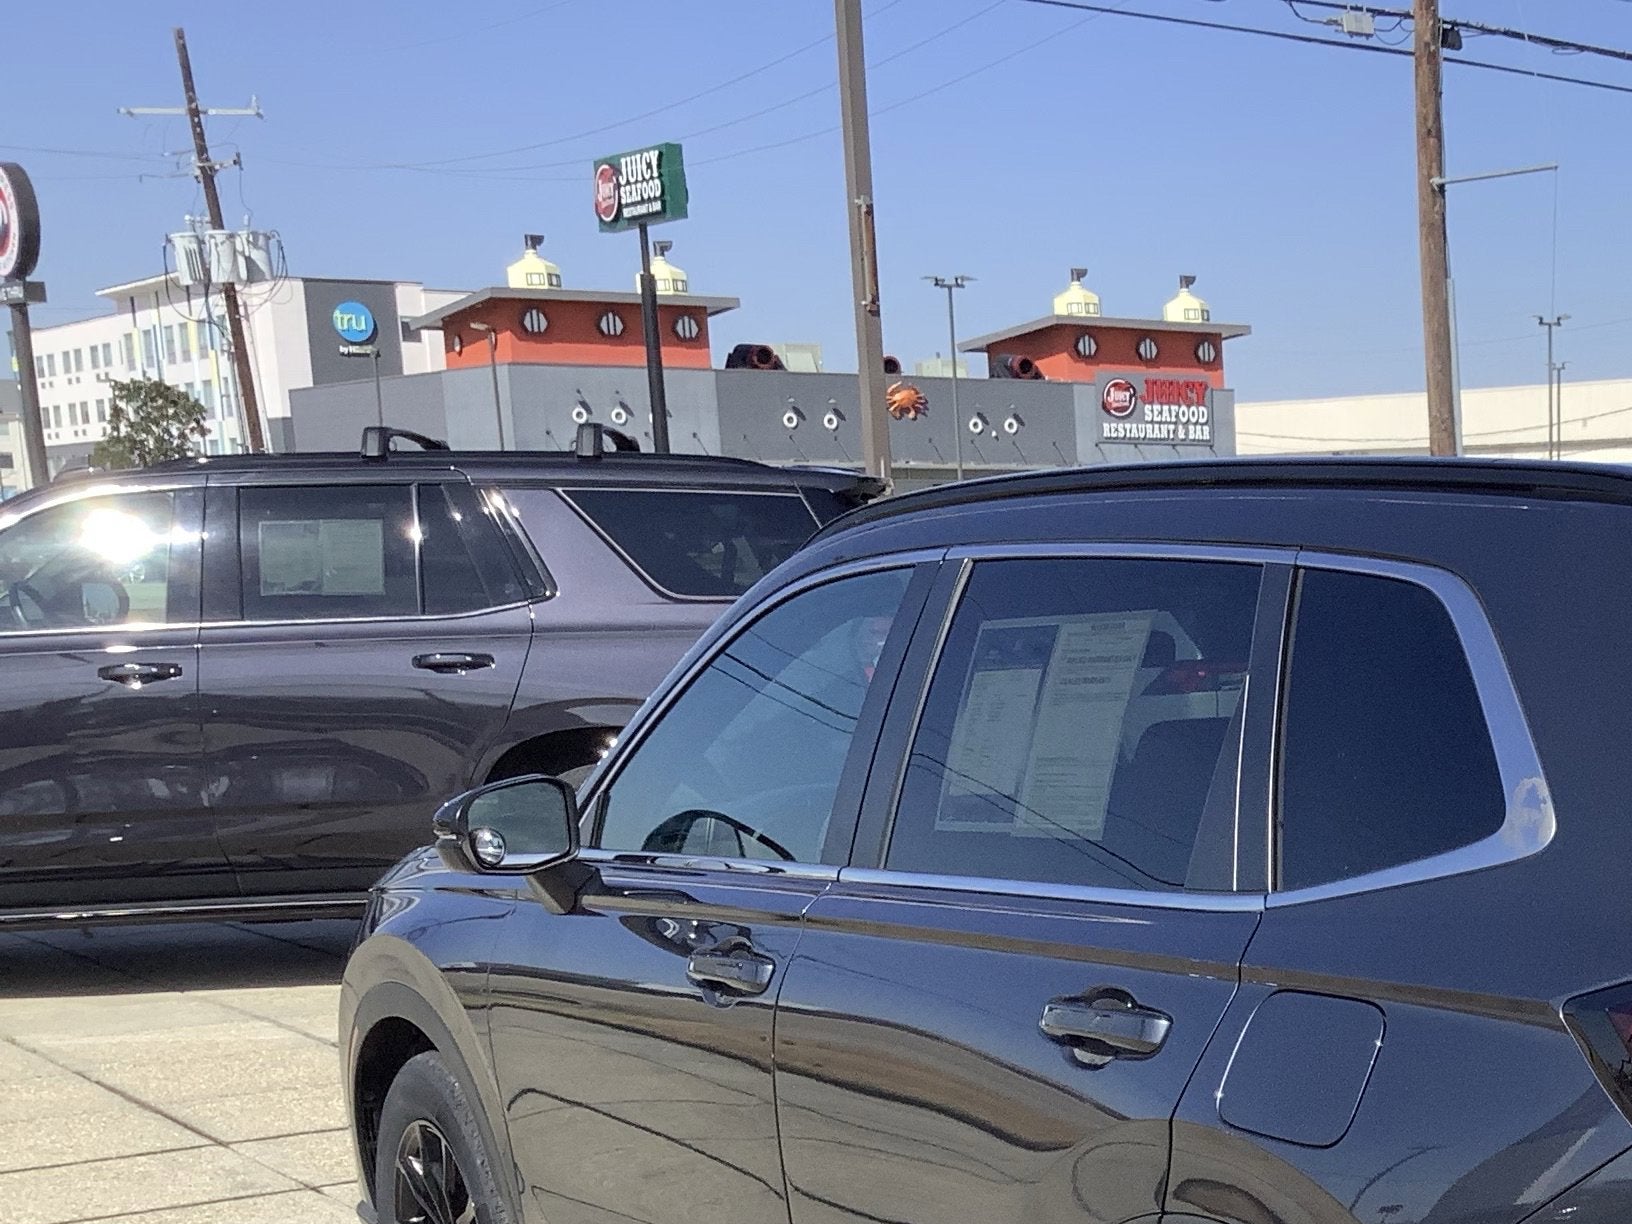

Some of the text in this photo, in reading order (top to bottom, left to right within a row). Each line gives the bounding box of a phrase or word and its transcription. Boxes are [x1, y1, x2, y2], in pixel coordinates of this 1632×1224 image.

[619, 150, 659, 185] JUICY
[620, 179, 662, 205] SEAFOOD
[335, 309, 367, 331] tru
[1139, 379, 1208, 405] JUICY
[1144, 404, 1208, 424] SEAFOOD
[1103, 422, 1210, 440] RESTAURANT & BAR
